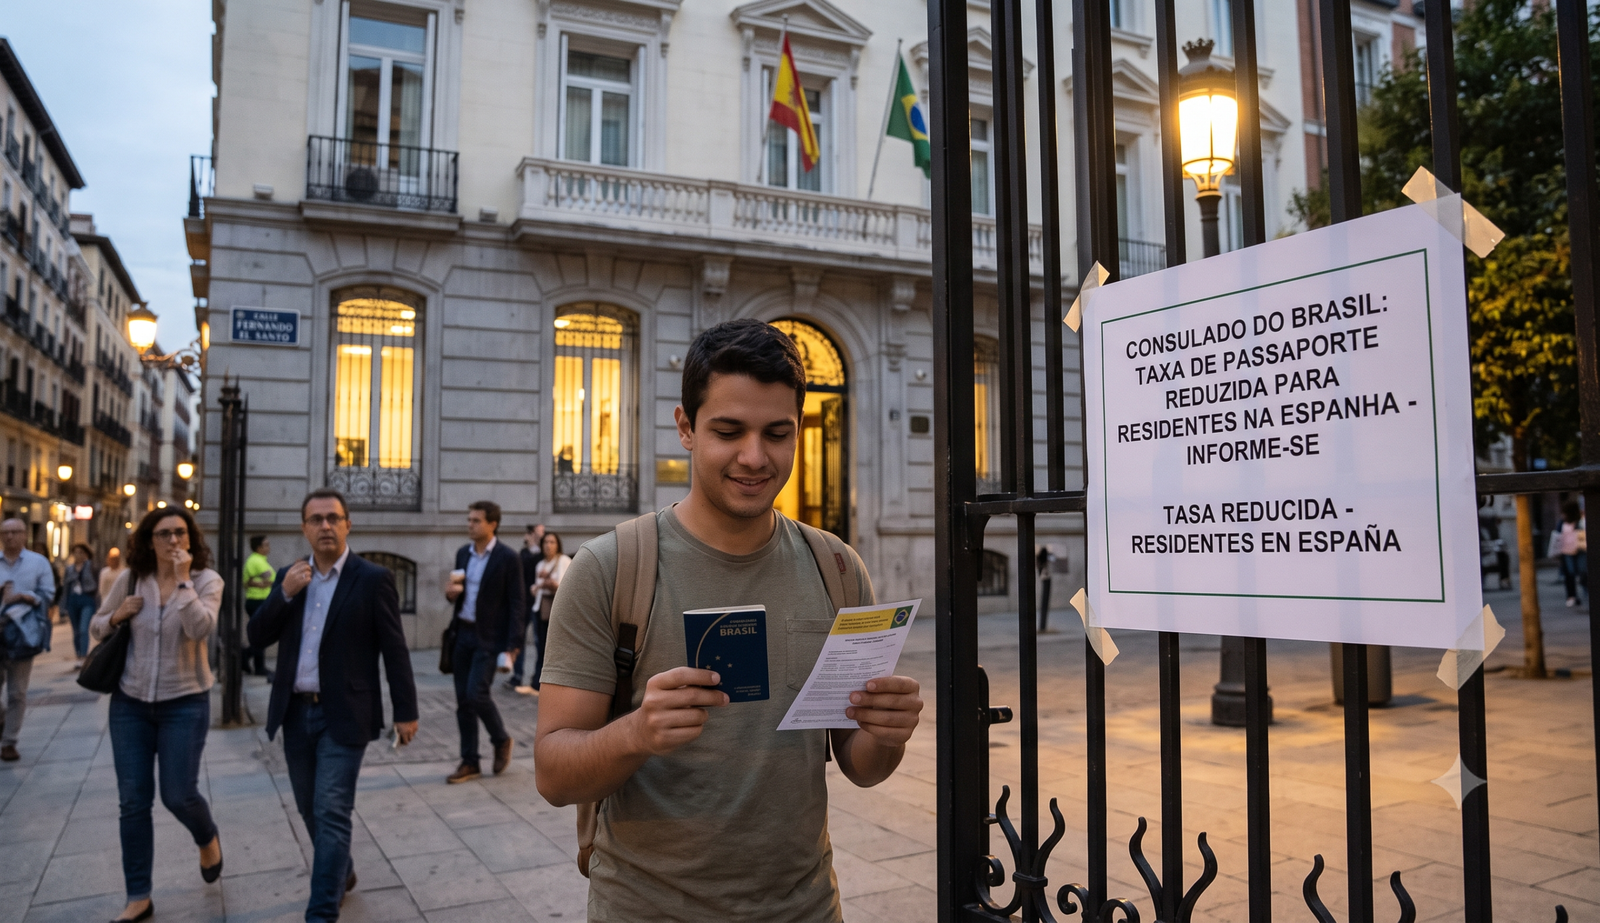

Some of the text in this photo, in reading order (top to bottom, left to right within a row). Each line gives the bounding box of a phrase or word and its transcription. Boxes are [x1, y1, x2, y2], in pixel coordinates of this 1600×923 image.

[236, 319, 294, 334] FERNANDO
[253, 312, 279, 321] CALLE
[1126, 292, 1388, 360] CONSULADO DO BRASIL:
[238, 331, 290, 342] EL SANTO
[1135, 325, 1379, 386] TAXA DE PASSAPORTE
[1165, 366, 1340, 410] REDUZIDA PARA
[1117, 411, 1237, 444] RESIDENTES
[1244, 407, 1275, 430] NA
[1280, 391, 1400, 426] ESPANHA
[1187, 433, 1320, 466] INFORME-SE
[1162, 503, 1216, 525] TASA
[1221, 497, 1338, 523] REDUCIDA
[1131, 523, 1402, 554] RESIDENTES EN ESPAÑA
[720, 628, 758, 637] BRASIL
